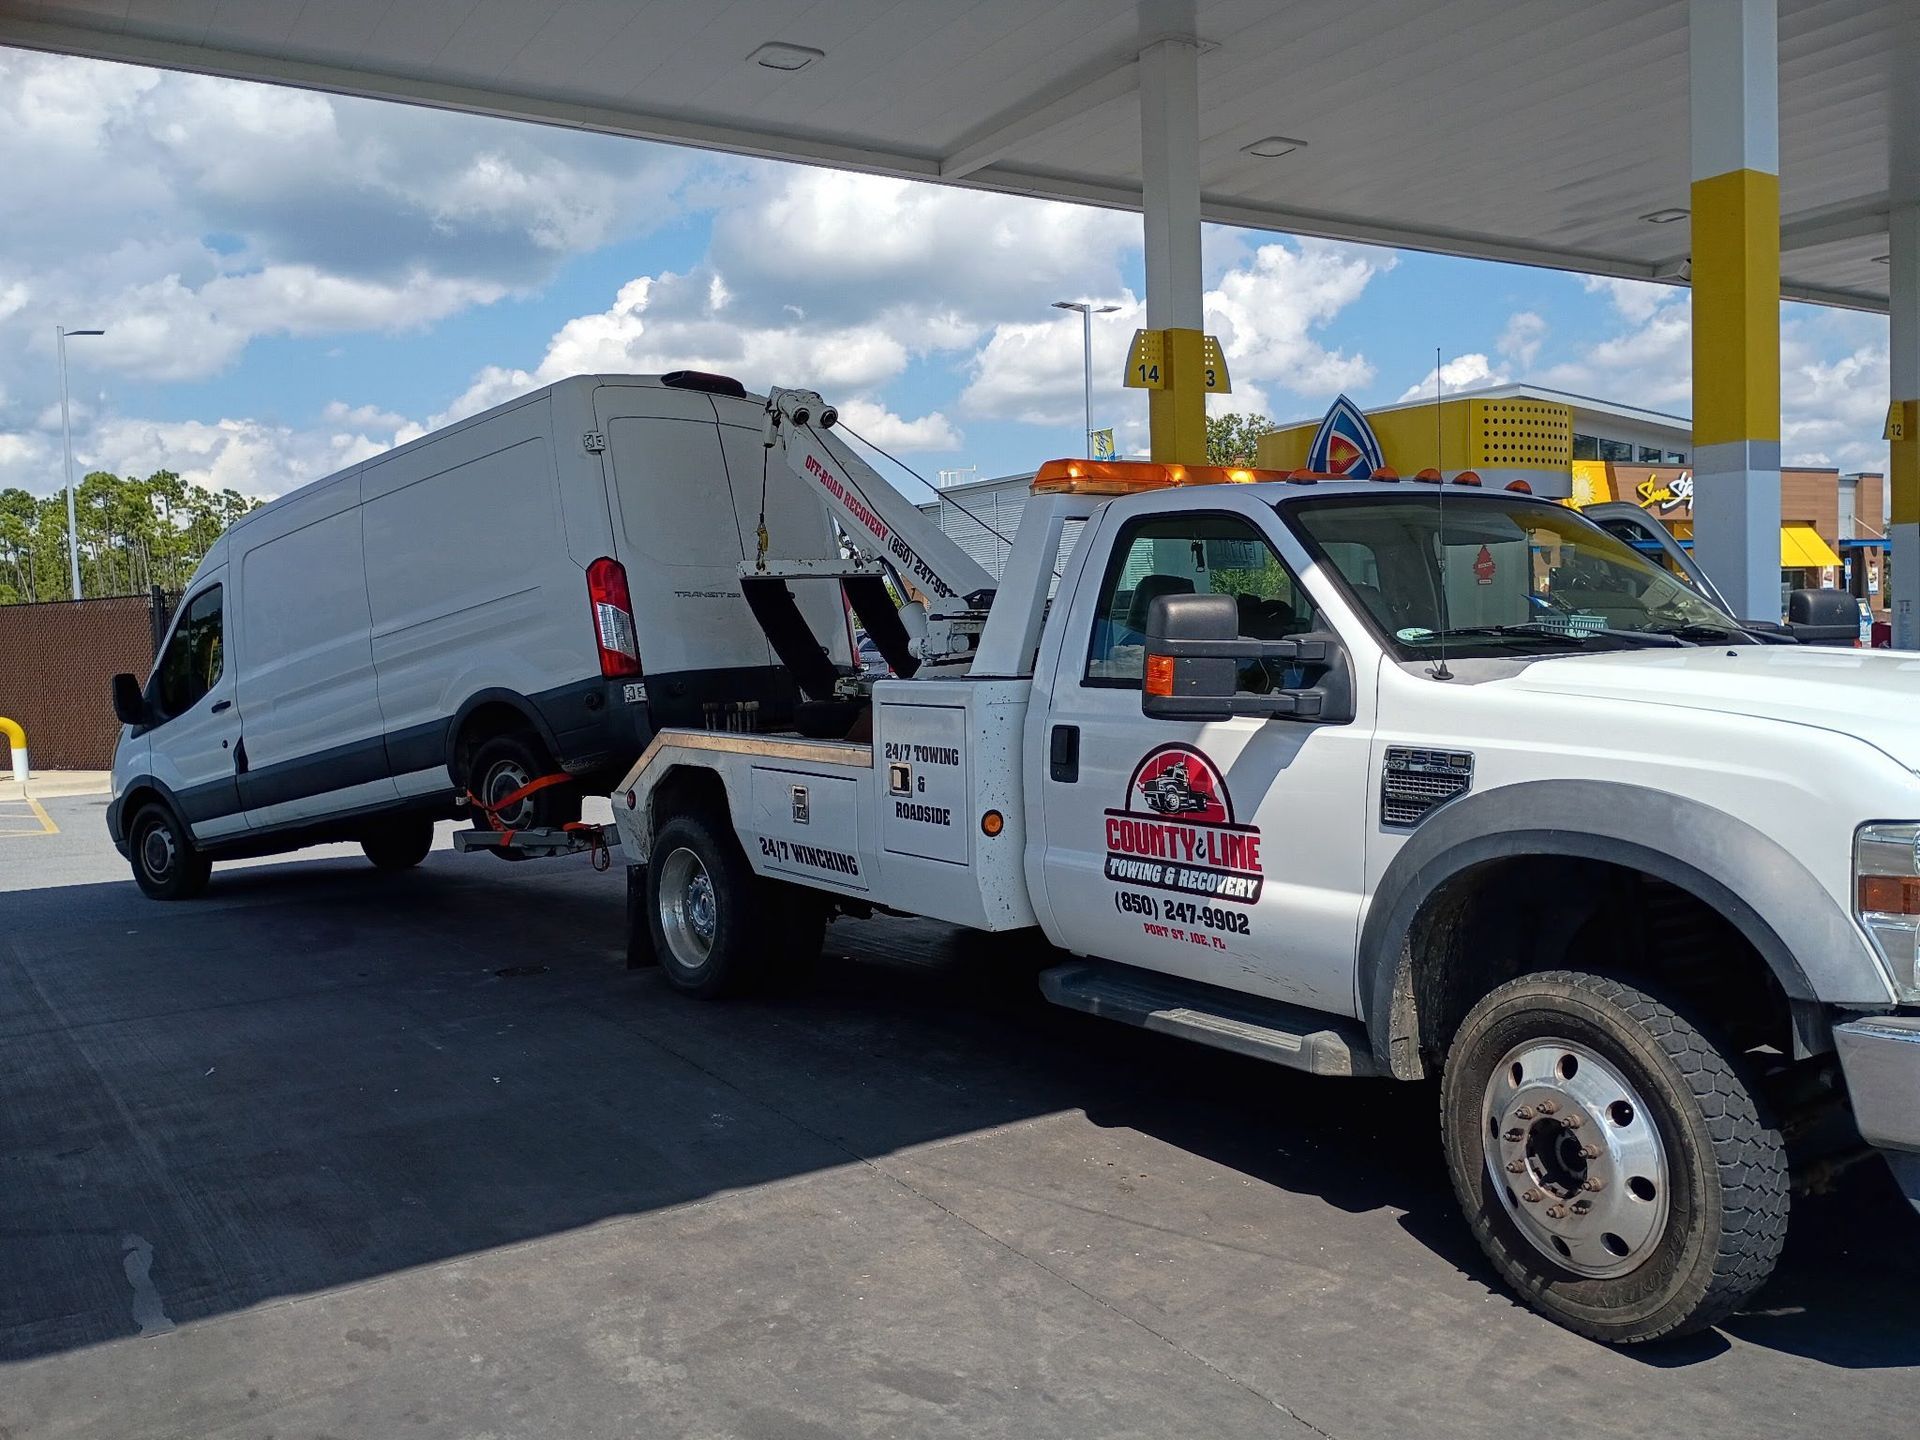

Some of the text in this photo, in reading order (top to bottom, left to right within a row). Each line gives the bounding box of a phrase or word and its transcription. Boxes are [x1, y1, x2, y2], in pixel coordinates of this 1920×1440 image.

[1138, 364, 1159, 383] 14
[1205, 369, 1215, 387] 3
[1890, 423, 1902, 437] 12
[1637, 473, 1671, 508] Sun
[805, 454, 958, 597] OFF-ROAD RECOVERY (850) 247-99
[885, 742, 959, 766] 24/7 TOWING
[917, 775, 926, 793] &
[895, 801, 951, 827] ROADSIDE
[759, 837, 859, 876] 24/7 WINCHING
[1105, 818, 1262, 872] COUNTY LINE
[1109, 858, 1259, 900] TOWING & RECOVERY
[1115, 891, 1251, 936] (850) 247-9902
[1143, 922, 1226, 949] PORT ST. JOE, FL
